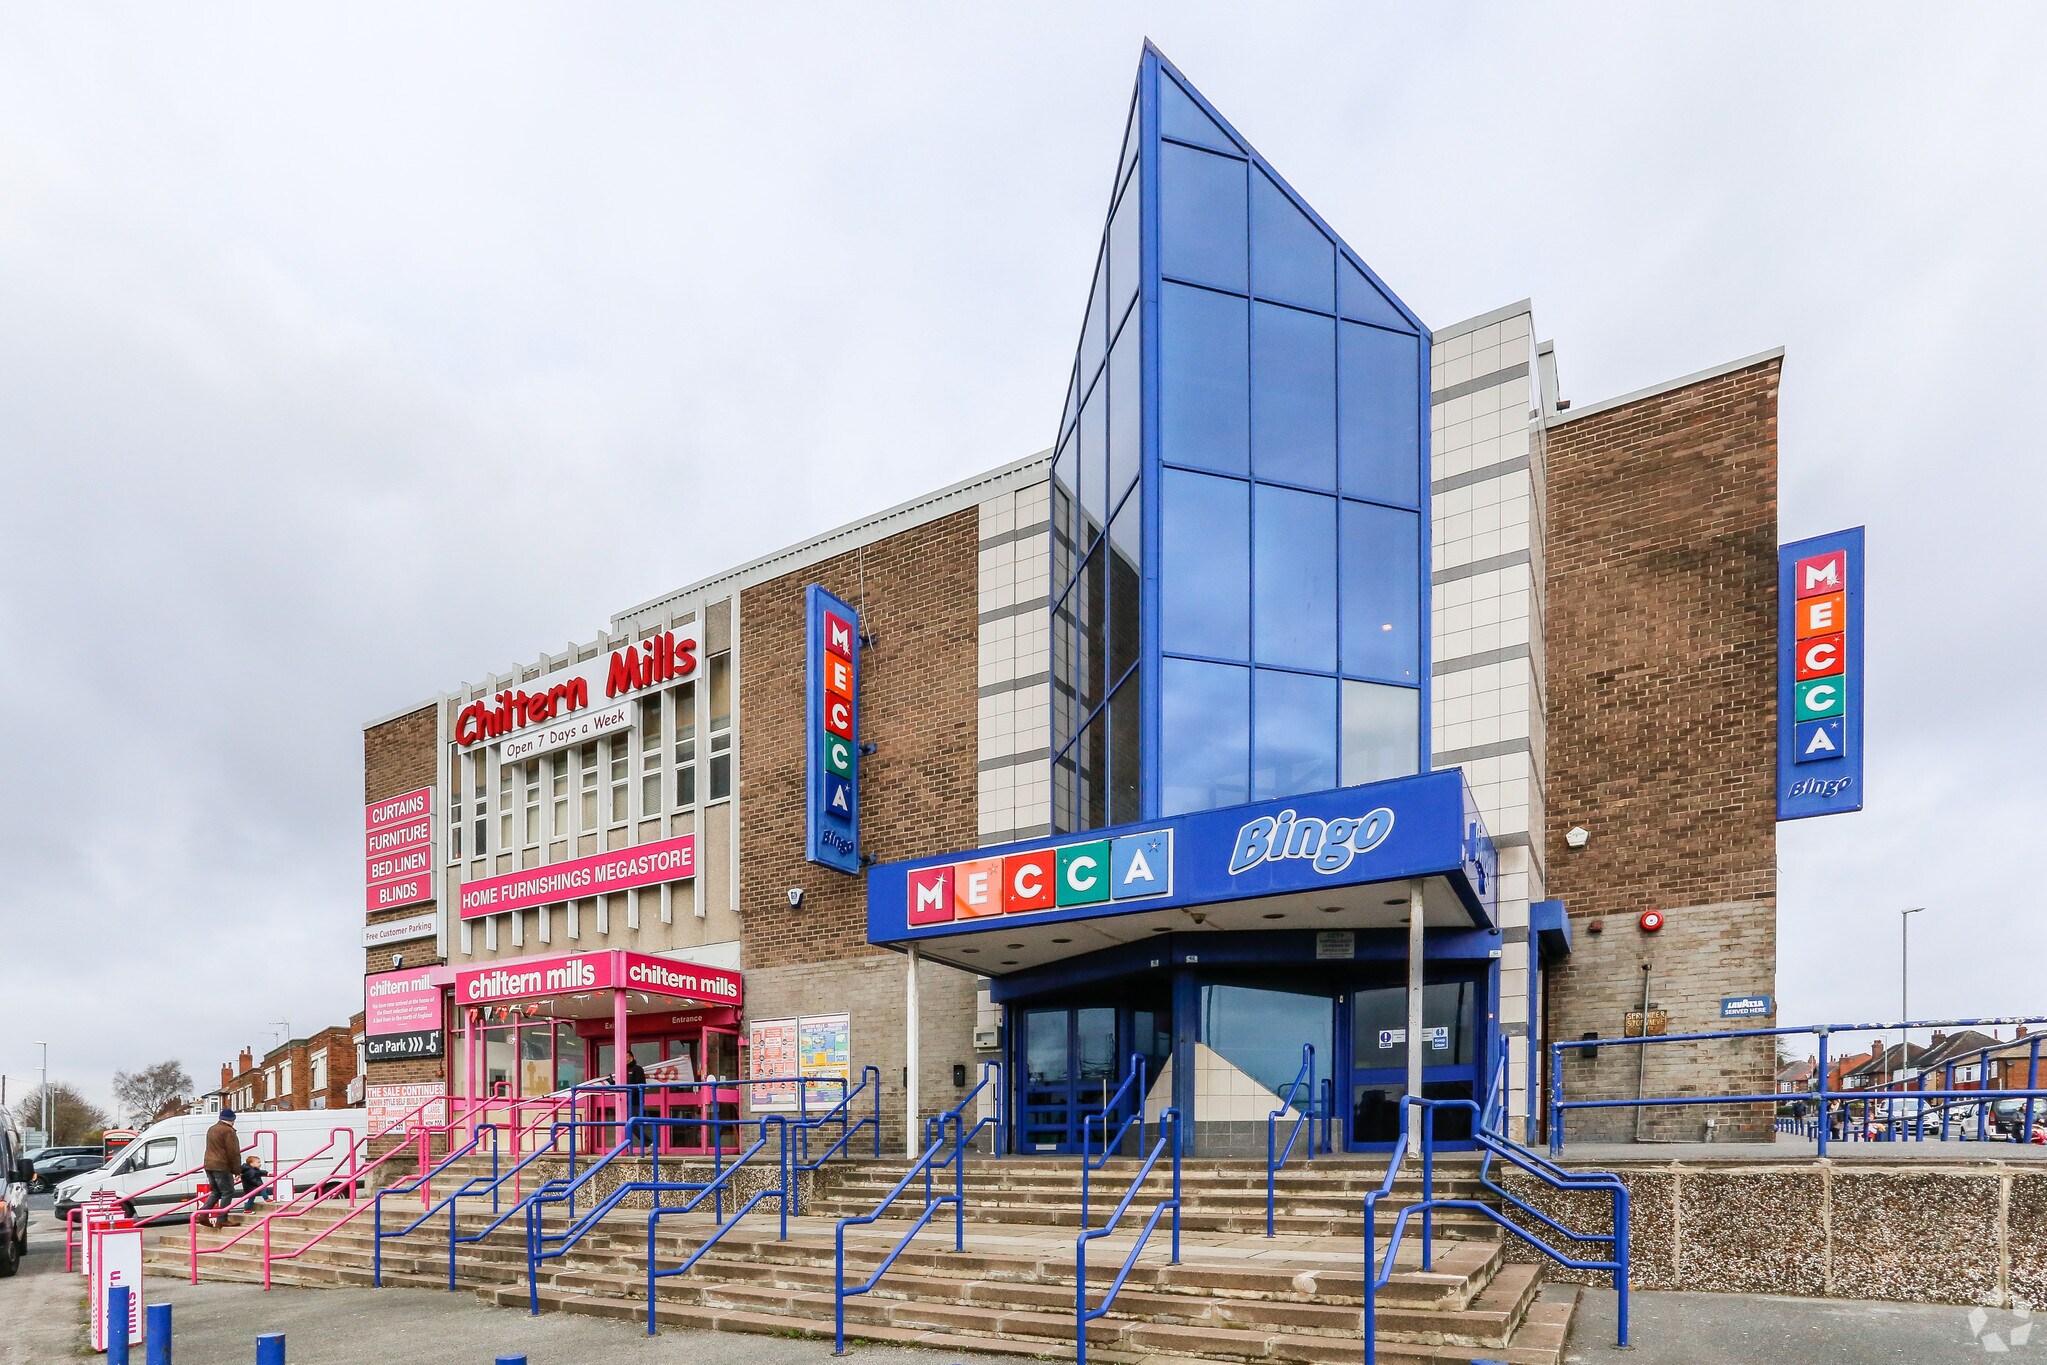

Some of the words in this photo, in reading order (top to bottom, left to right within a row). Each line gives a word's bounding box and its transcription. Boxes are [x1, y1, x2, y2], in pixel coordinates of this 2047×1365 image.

[1804, 560, 1837, 754] MECCA
[455, 676, 588, 746] Chiltern
[605, 631, 697, 698] Mills
[831, 620, 849, 812] MECCA
[507, 741, 533, 757] Open
[538, 734, 545, 747] 7
[550, 727, 576, 744] Days
[581, 725, 588, 734] a
[594, 709, 625, 730] Week
[1788, 776, 1853, 799] Bingo
[372, 796, 424, 823] CURTAINS
[369, 823, 428, 852] FURNITURE
[821, 828, 855, 857] Bingo
[1228, 808, 1395, 875] Bingo
[372, 860, 392, 878] BED
[394, 852, 426, 873] LINEN
[462, 887, 498, 909] HOME
[501, 868, 591, 901] FURNISHINGS
[595, 847, 692, 883] MEGASTORE
[379, 882, 418, 904] BLINDS
[916, 849, 1155, 913] MECCA
[366, 932, 379, 941] Free
[380, 927, 407, 939] Customer
[408, 922, 432, 933] Parking
[369, 979, 409, 997] chiltern
[468, 970, 542, 1000] chiltern
[546, 959, 596, 990] mills
[629, 963, 697, 991] chiltern
[700, 976, 738, 998] mills
[1626, 1011, 1666, 1020] SPRIKLER
[1727, 999, 1764, 1009] LAVAZZA
[604, 1022, 615, 1030] Exi
[671, 1014, 703, 1024] Entrance
[368, 1041, 384, 1054] Car
[385, 1038, 407, 1053] Park
[367, 1087, 382, 1098] THE
[383, 1086, 400, 1097] SALE
[401, 1084, 444, 1096] CONTINUES
